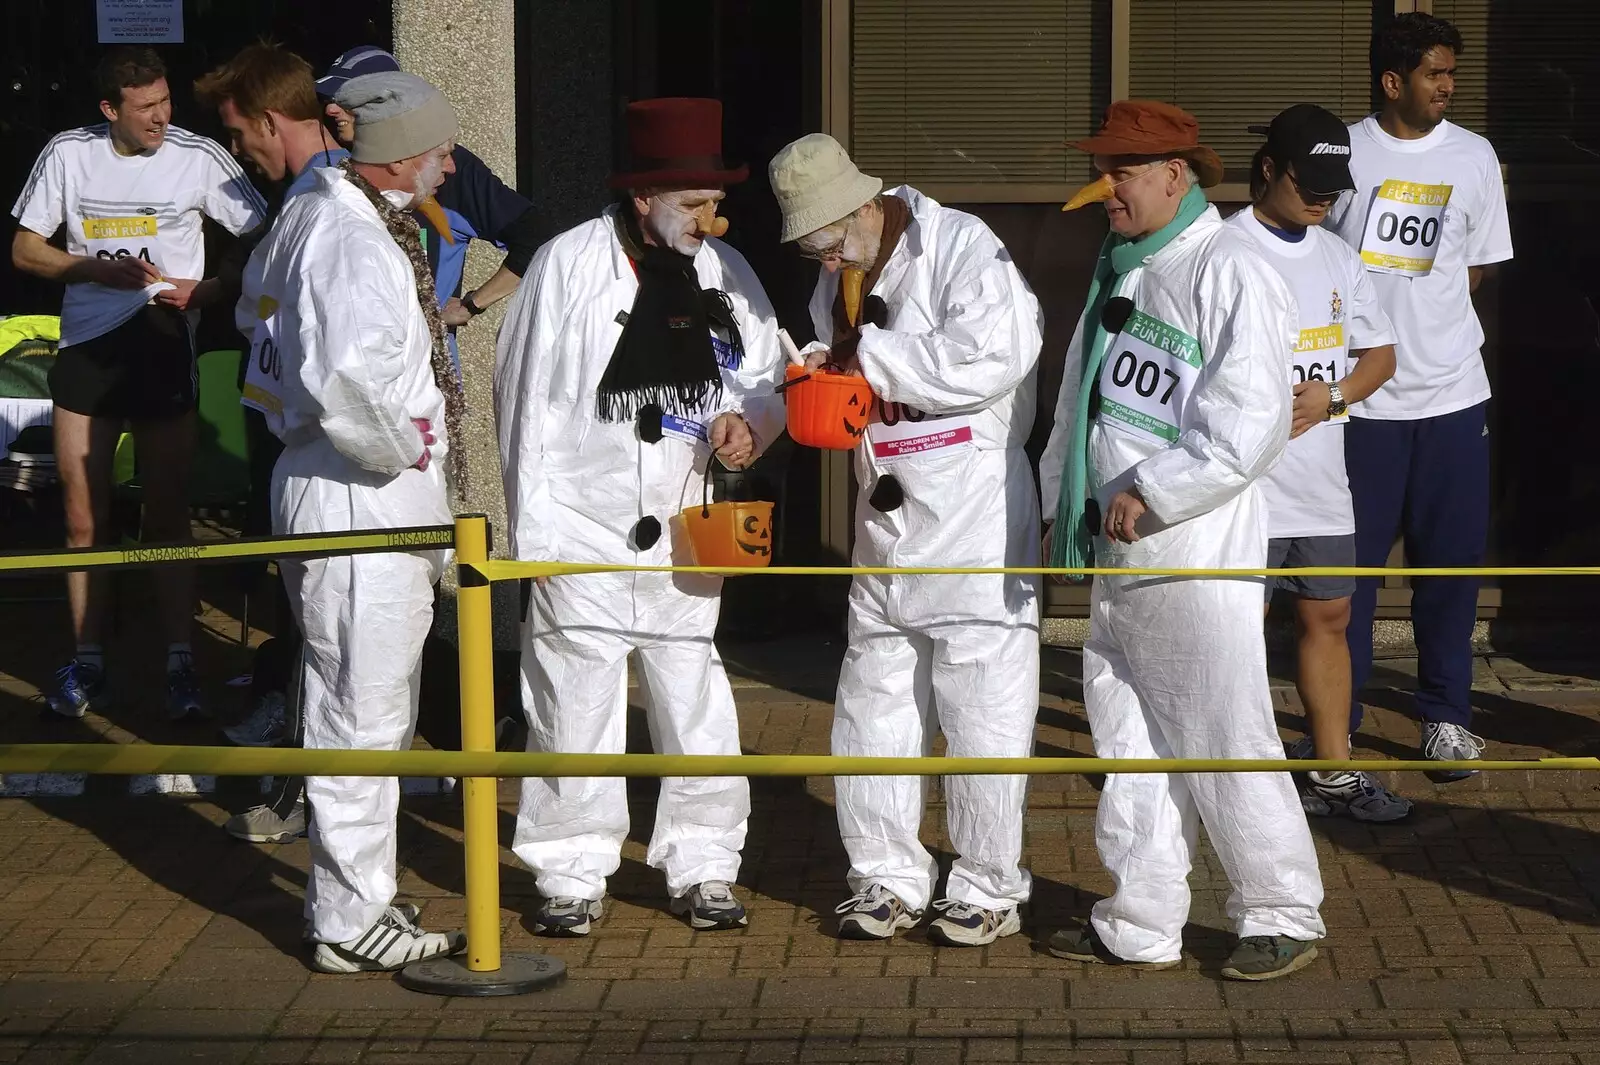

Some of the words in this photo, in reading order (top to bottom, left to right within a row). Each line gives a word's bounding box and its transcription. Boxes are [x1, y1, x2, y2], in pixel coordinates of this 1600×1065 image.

[1387, 188, 1415, 202] FUN
[1419, 192, 1445, 205] RUN
[94, 226, 117, 238] FUN
[122, 225, 148, 237] RUN
[1376, 211, 1439, 247] 060
[1137, 315, 1196, 349] CAMBRIDGE
[1130, 322, 1159, 344] FUN
[1160, 336, 1193, 361] RUN
[1296, 338, 1314, 351] UN
[1317, 335, 1337, 349] RUN
[259, 337, 282, 381] 00
[1112, 350, 1181, 406] 007
[879, 399, 943, 427] 00
[1110, 409, 1129, 422] Raise
[1115, 403, 1145, 421] CHILDREN
[1144, 416, 1152, 424] IN
[1151, 418, 1168, 430] NEED
[899, 445, 917, 454] Raise
[923, 440, 946, 451] Smile!
[900, 437, 931, 448] CHILDREN
[939, 431, 957, 440] NEED
[387, 529, 453, 547] TENSABARRI
[122, 545, 200, 563] TENSABARRIER
